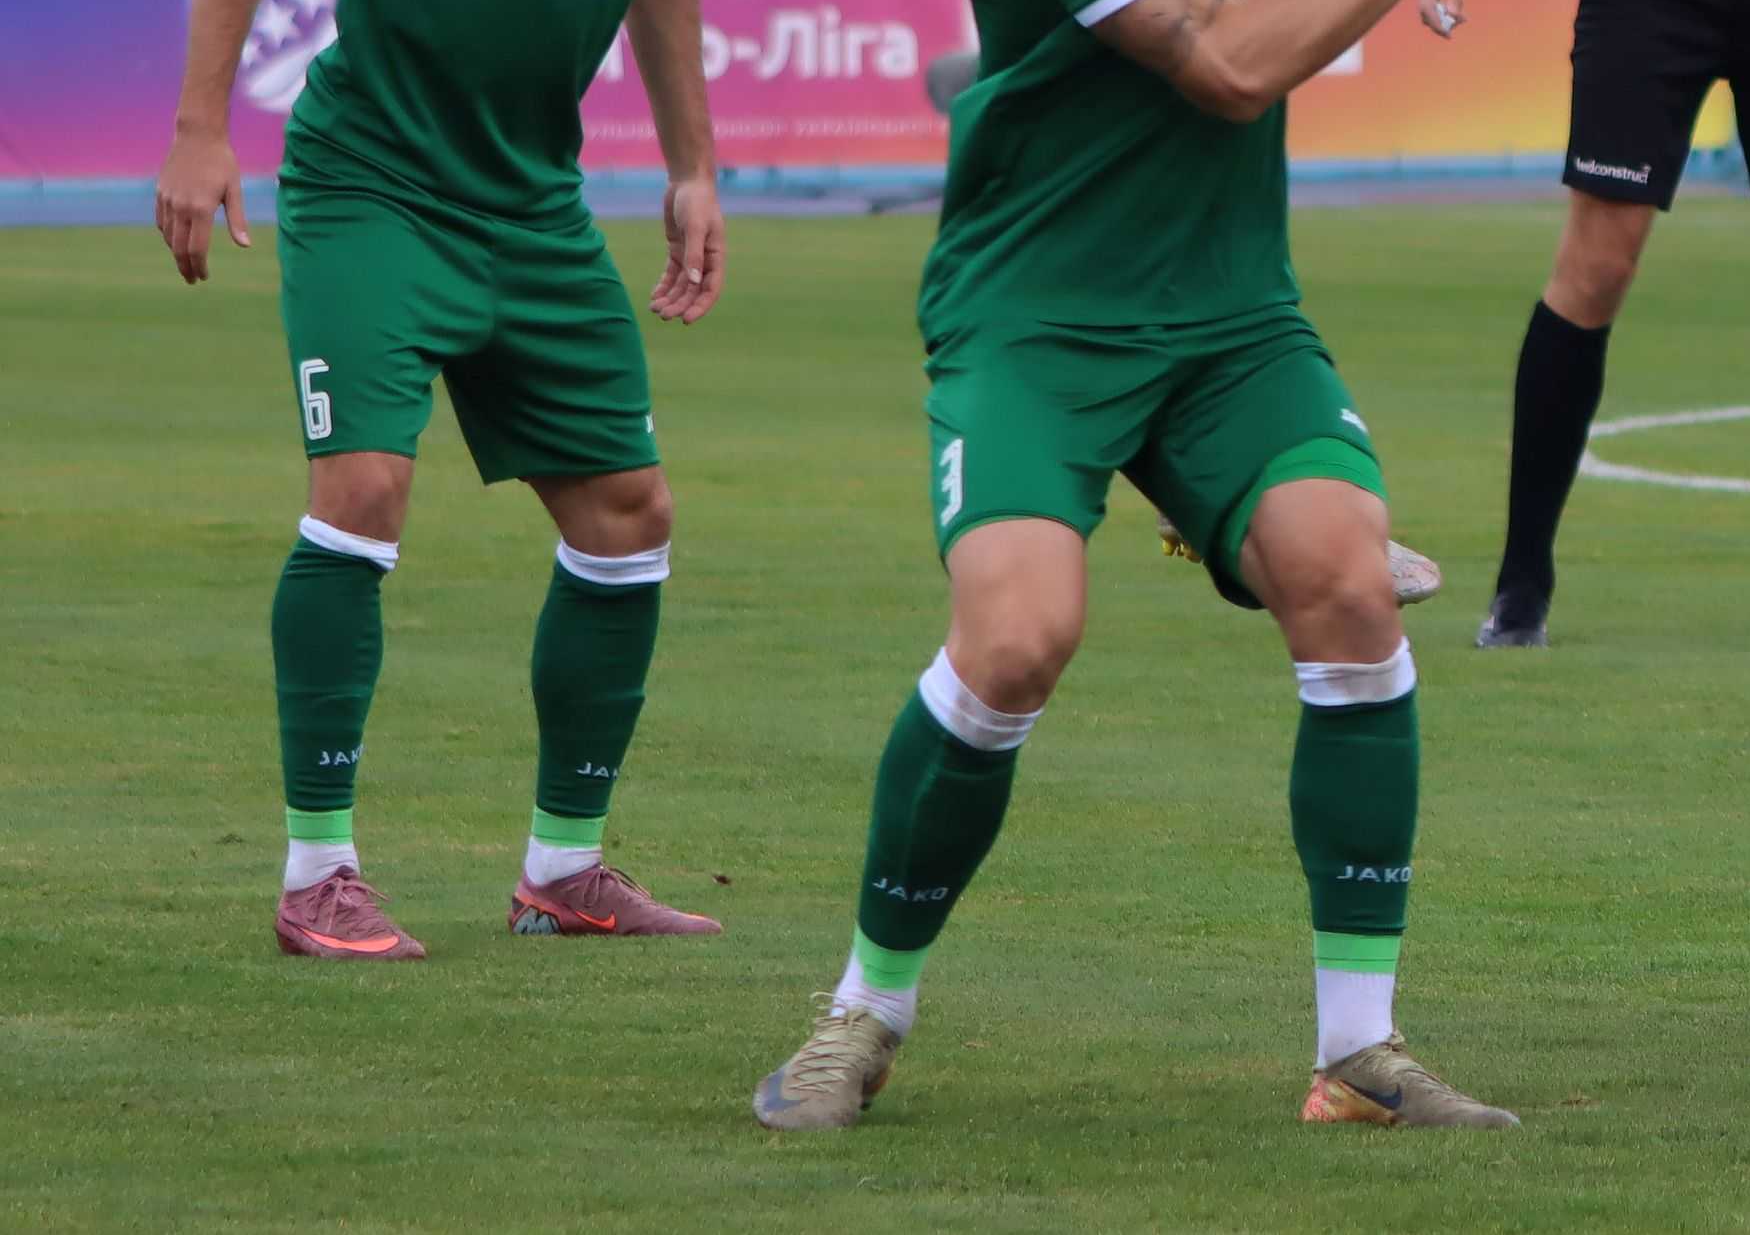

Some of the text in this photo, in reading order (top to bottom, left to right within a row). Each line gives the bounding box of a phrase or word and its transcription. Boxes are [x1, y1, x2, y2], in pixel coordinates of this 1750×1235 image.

[300, 358, 332, 440] 6
[1336, 865, 1414, 883] JAKO
[872, 877, 949, 901] JAKO
